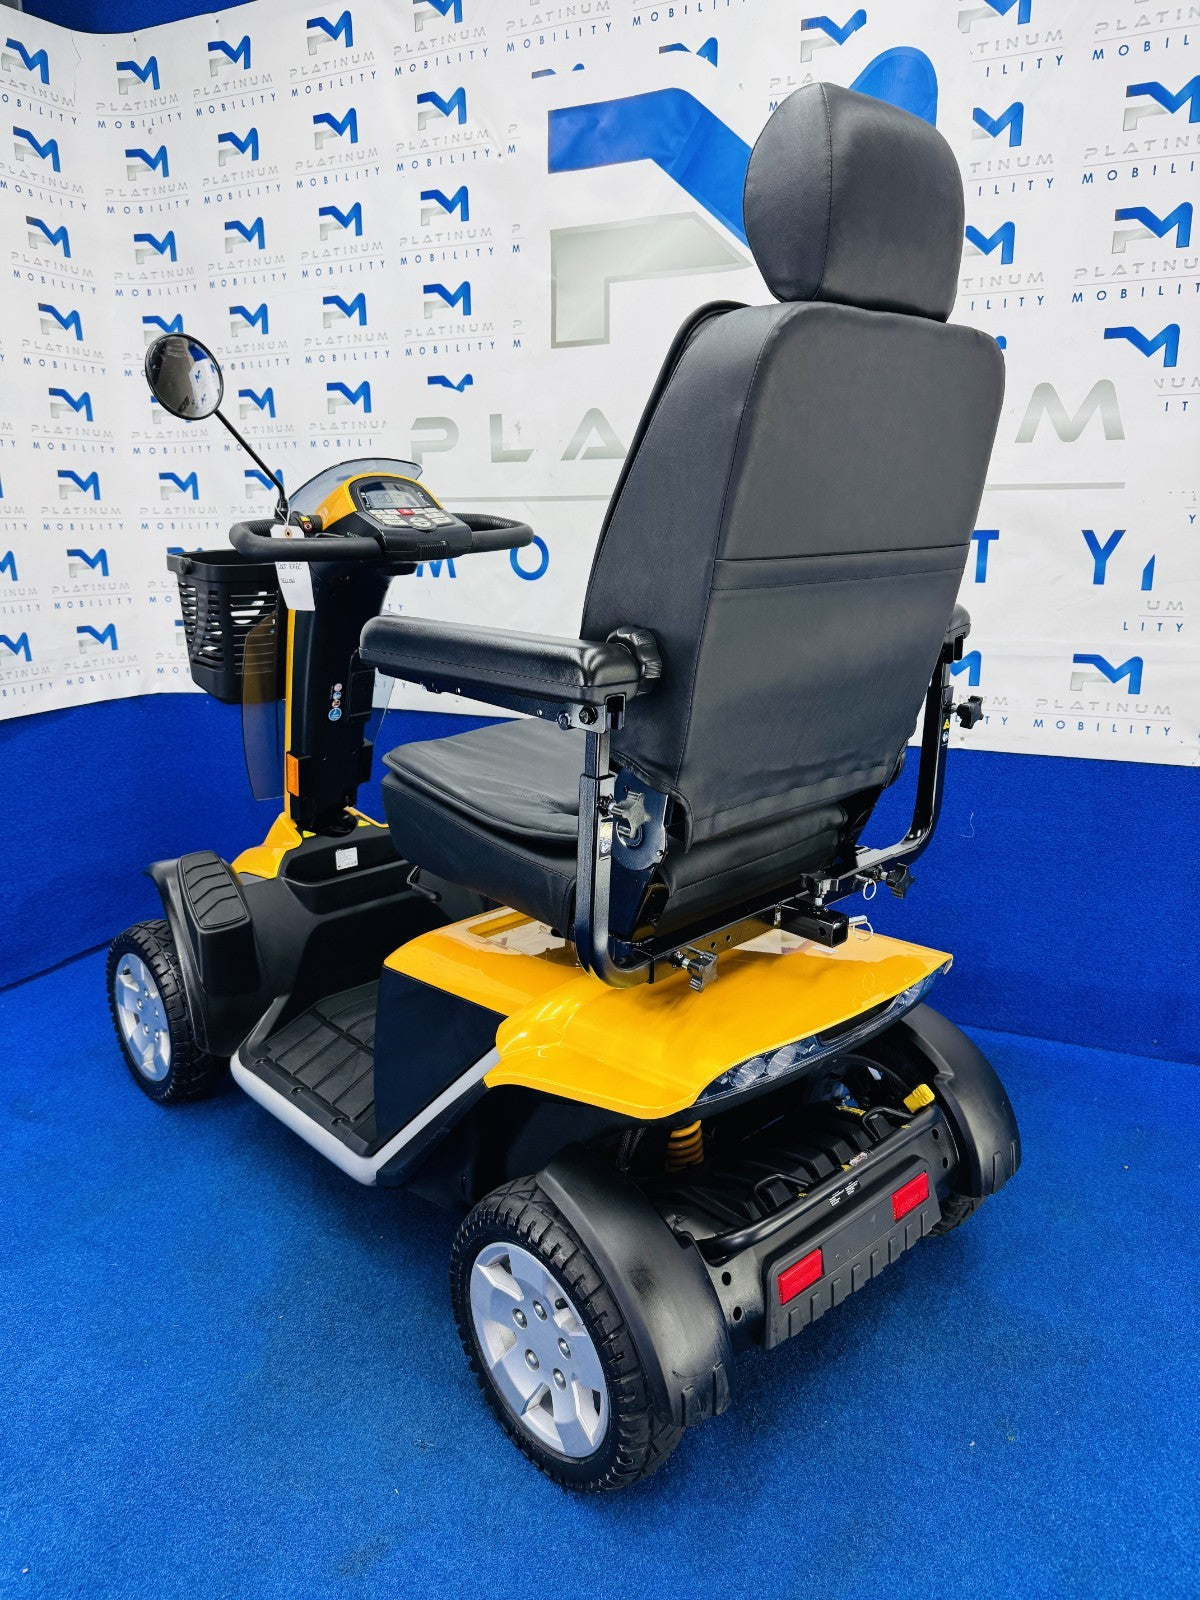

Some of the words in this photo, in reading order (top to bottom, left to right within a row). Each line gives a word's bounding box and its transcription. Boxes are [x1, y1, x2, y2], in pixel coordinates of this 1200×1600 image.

[506, 1, 612, 31] PLATINUM
[393, 26, 487, 56] PLATINUM
[506, 22, 612, 52] MOBILITY
[970, 28, 1064, 55] TINUM
[289, 51, 375, 79] PLATINUM
[394, 47, 489, 77] MOBILITY
[0, 79, 75, 107] ATINUM
[193, 74, 273, 98] PLATINUM
[291, 70, 377, 98] MOBILITY
[96, 93, 179, 111] PLATINUM
[196, 92, 277, 117] MOBILITY
[97, 112, 183, 129] MOBILITY
[396, 128, 489, 153] PLATINUM
[295, 147, 379, 171] PLATINUM
[396, 148, 490, 172] MOBILITY
[203, 165, 279, 187] PLATINUM
[296, 166, 381, 189] MOBILITY
[0, 180, 87, 212] MOBILITY
[105, 182, 188, 197] PLATINUM
[203, 184, 281, 205] MOBILITY
[106, 198, 190, 214] MOBILITY
[400, 226, 492, 247] PLATINUM
[301, 241, 384, 261] PLATINUM
[400, 247, 494, 266] MOBILITY
[11, 251, 94, 279] PLATINUM
[208, 254, 286, 272] PLATINUM
[302, 260, 386, 279] MOBILITY
[13, 269, 97, 295] MOBILITY
[113, 266, 196, 281] PLATINUM
[209, 273, 288, 290] MOBILITY
[115, 284, 198, 298] MOBILITY
[304, 331, 389, 347] PLATINUM
[404, 321, 495, 338] PLATINUM
[22, 339, 104, 360] PLATINUM
[305, 350, 391, 365] MOBILITY
[405, 341, 496, 358] MOBILITY
[23, 357, 107, 375] MOBILITY
[31, 424, 114, 438] PLATINUM
[33, 440, 116, 454] MOBILITY
[133, 444, 212, 456] MOBILITY
[41, 506, 122, 516] PLATINUM
[139, 506, 219, 515] PLATINUM
[43, 523, 125, 531] MOBILITY
[141, 521, 221, 531] MOBILITY
[54, 596, 133, 610] MOBILITY
[66, 668, 141, 686] MOBILITY
[1034, 697, 1171, 716] PLATINUM
[1032, 719, 1171, 736] MOBILITY
